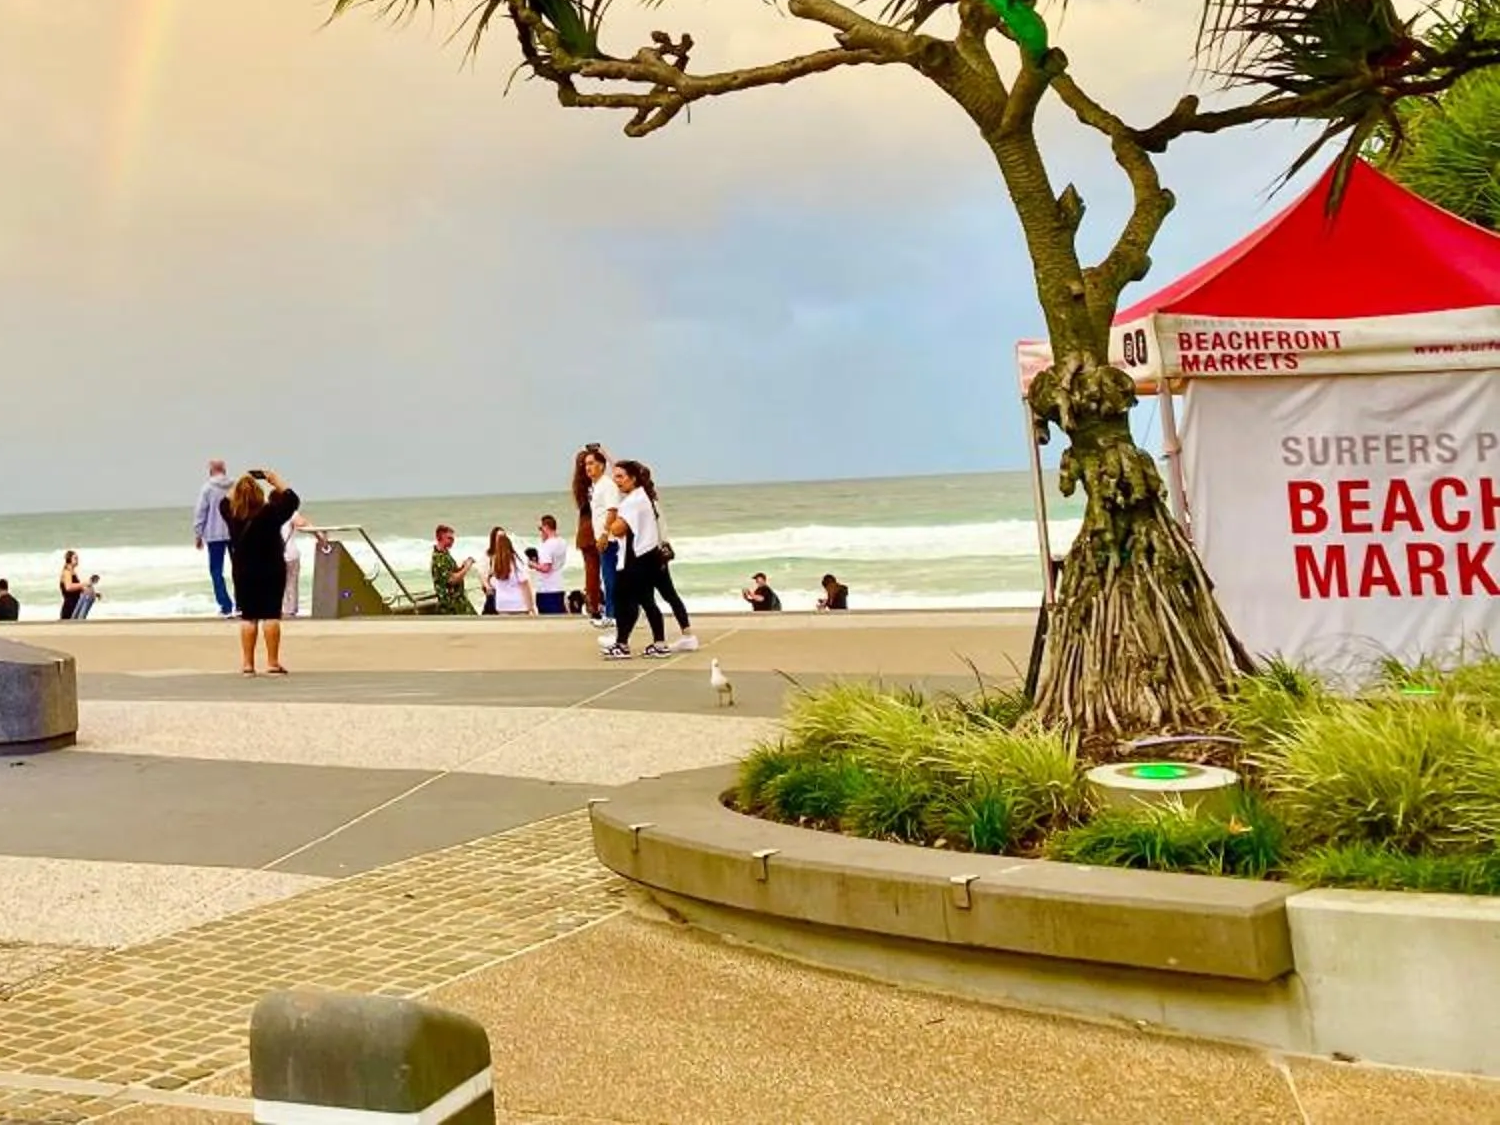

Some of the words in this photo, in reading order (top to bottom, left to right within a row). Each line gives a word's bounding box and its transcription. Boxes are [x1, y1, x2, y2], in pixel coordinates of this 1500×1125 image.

[1177, 330, 1341, 352] BEACHFRONT
[1181, 352, 1299, 372] MARKETS
[1281, 432, 1459, 467] SURFERS
[1476, 431, 1498, 463] P
[1294, 541, 1500, 600] MARK
